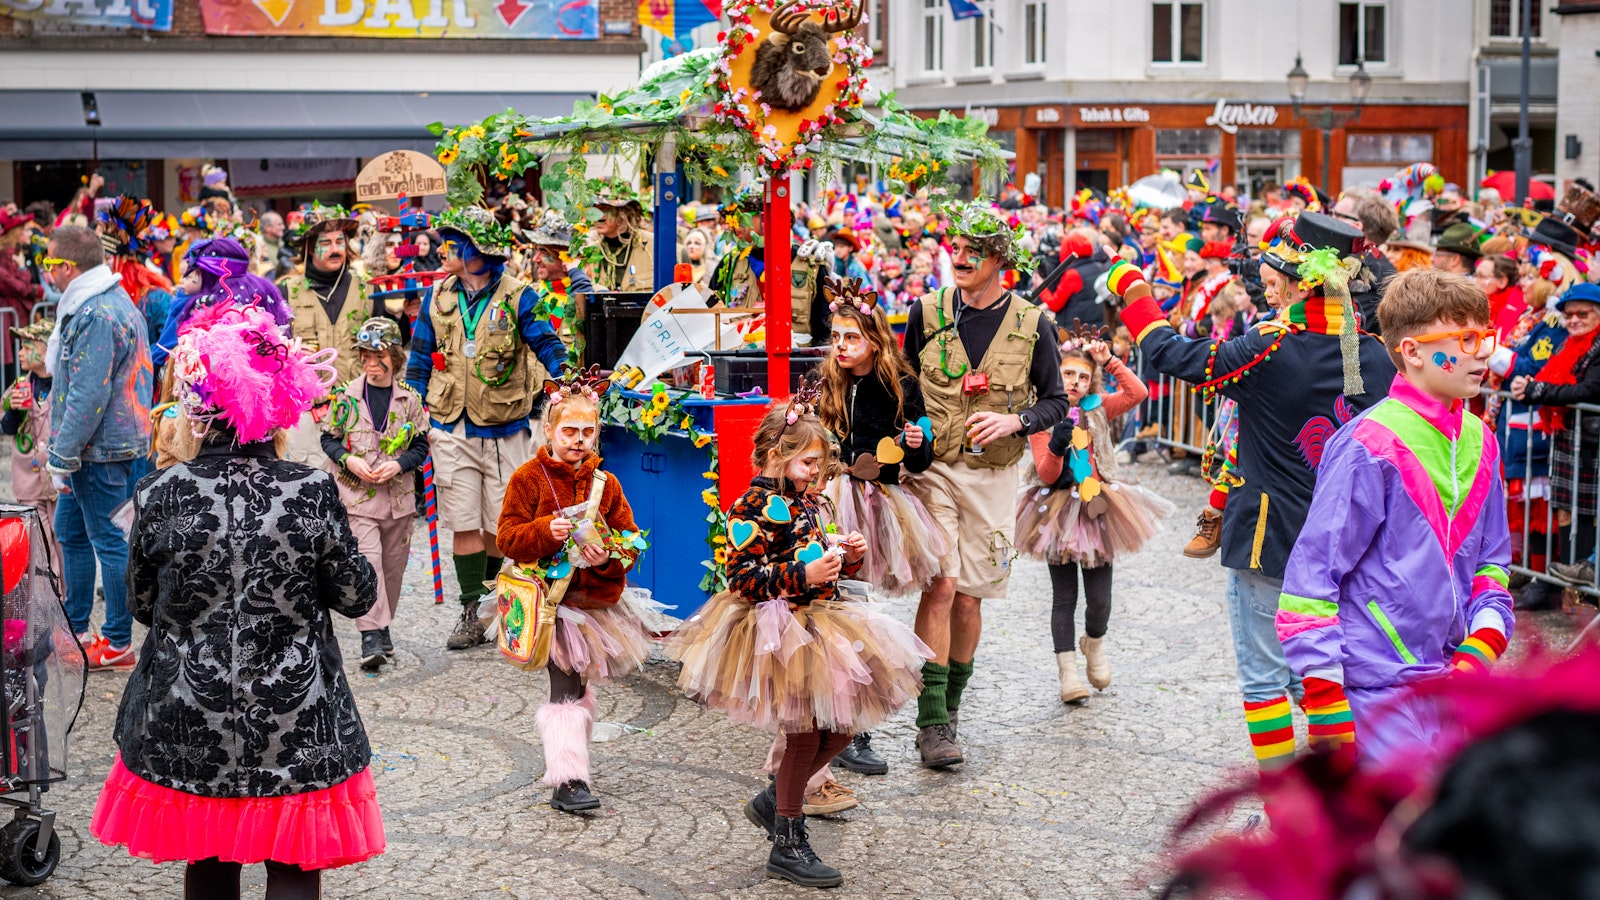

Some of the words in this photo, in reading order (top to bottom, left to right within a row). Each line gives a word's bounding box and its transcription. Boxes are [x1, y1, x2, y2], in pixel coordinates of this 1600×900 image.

[1080, 107, 1112, 122] Tabak
[1113, 108, 1122, 122] &
[1123, 107, 1150, 122] Gifts
[1206, 98, 1278, 134] Lensen
